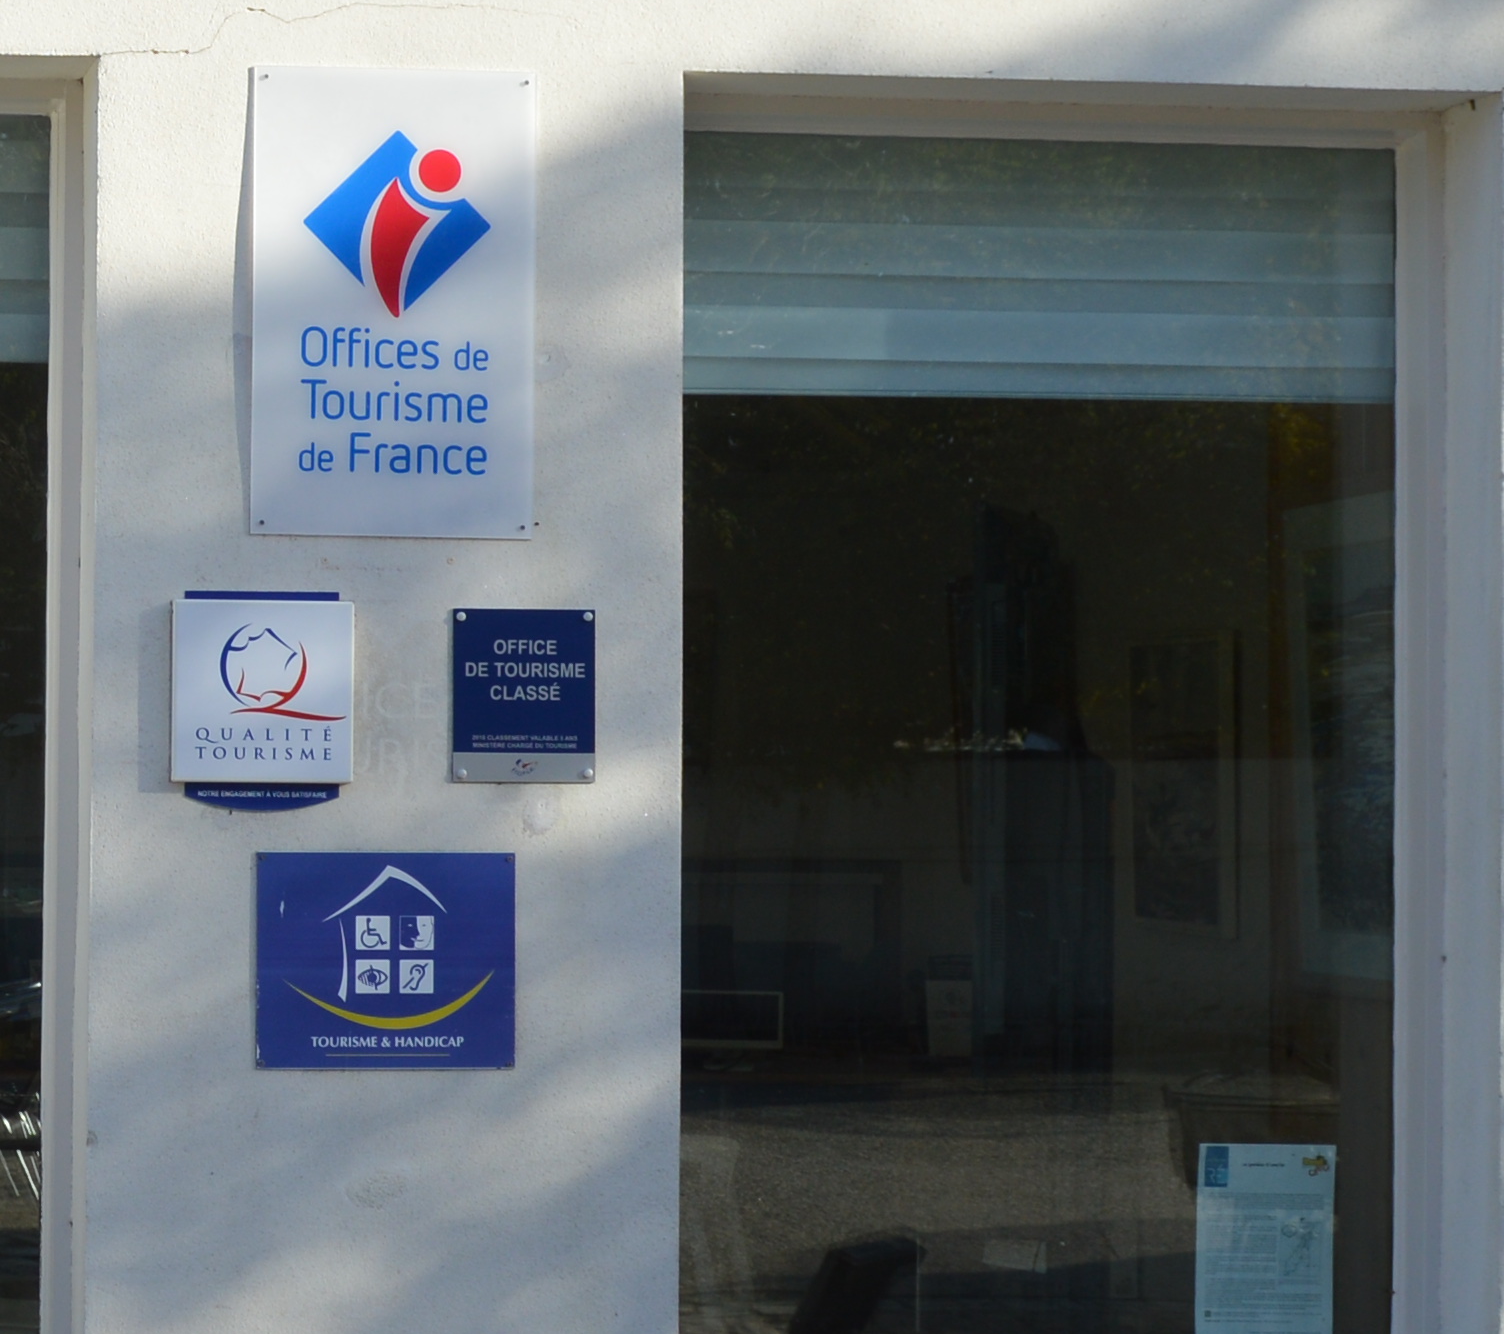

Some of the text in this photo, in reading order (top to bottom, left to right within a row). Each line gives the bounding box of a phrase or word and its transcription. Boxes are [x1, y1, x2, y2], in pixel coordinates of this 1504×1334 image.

[300, 326, 489, 371] Offices de
[300, 378, 489, 424] Tourisme
[298, 432, 488, 475] de France
[493, 638, 558, 656] OFFICE
[465, 662, 586, 679] DE TOURISME
[489, 682, 561, 702] CLASSÉ
[195, 725, 332, 744] QUALITÉ
[195, 746, 332, 761] TOURISME
[310, 1036, 464, 1048] TOURISME & HANDICAP
